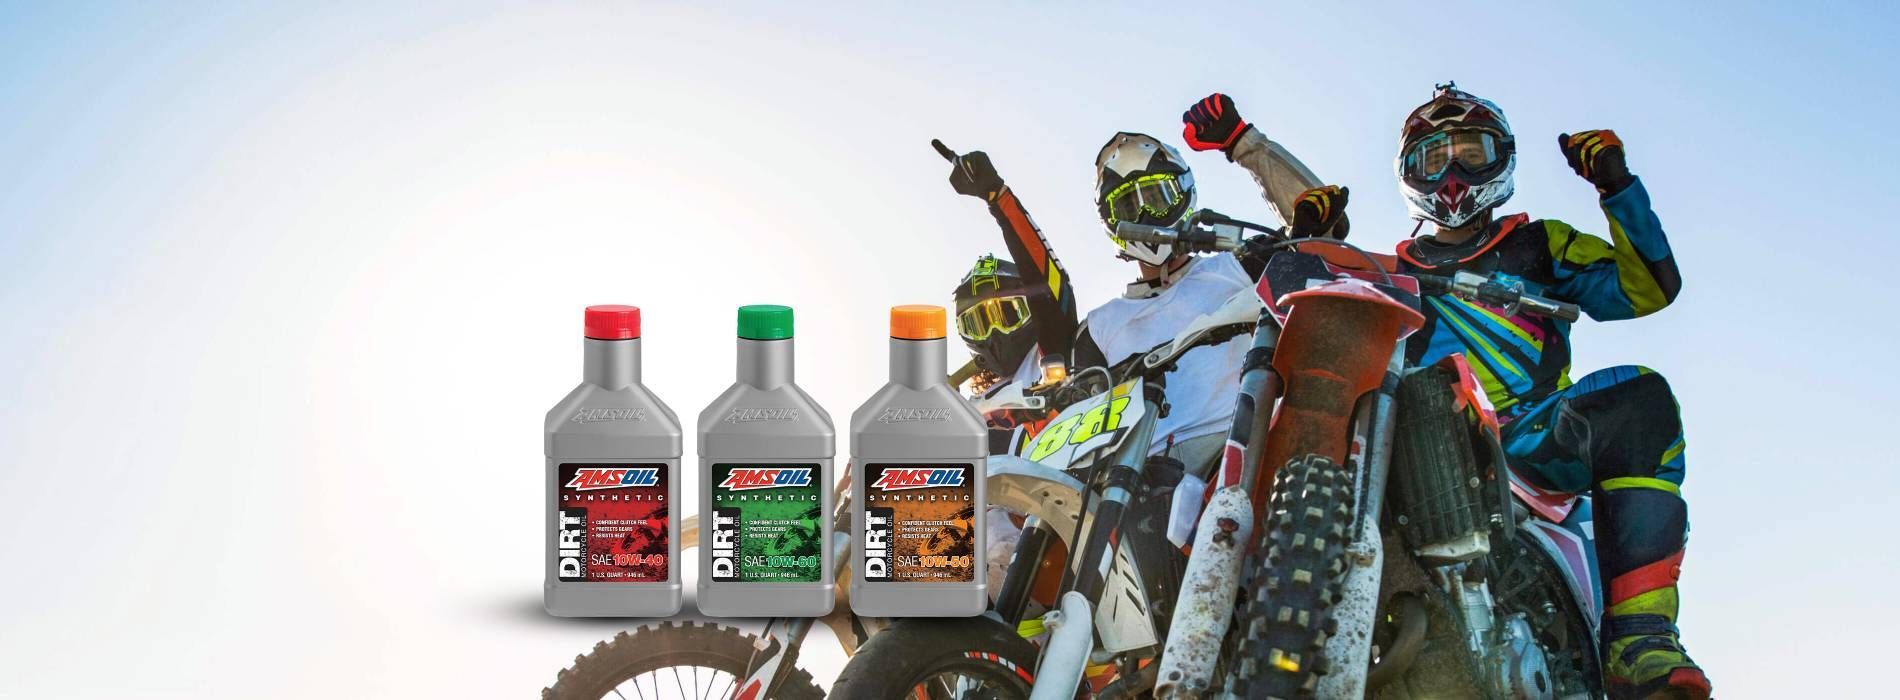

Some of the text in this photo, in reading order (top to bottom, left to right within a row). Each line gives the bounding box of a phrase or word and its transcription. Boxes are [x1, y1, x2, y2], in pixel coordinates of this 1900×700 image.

[1029, 396, 1131, 463] 88
[565, 468, 659, 491] AMSOIL
[718, 468, 812, 491] AMSOIL
[871, 468, 965, 491] AMSOIL
[560, 511, 580, 577] DIRT
[713, 511, 733, 577] DIRT
[866, 511, 886, 577] DIRT
[592, 554, 664, 565] SAE 10W-40
[745, 556, 817, 567] SAE 10W-60
[898, 556, 970, 567] SAE 10W-50
